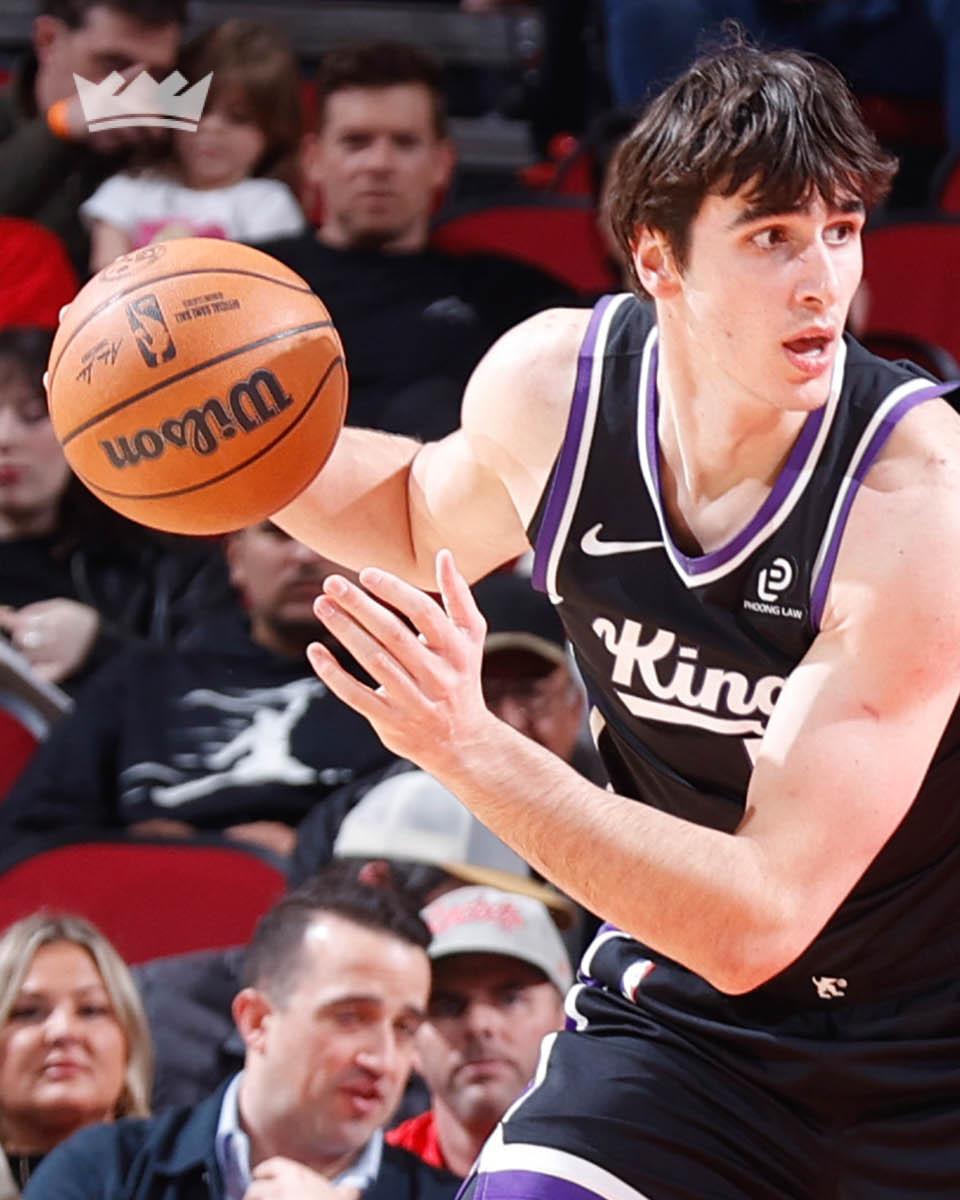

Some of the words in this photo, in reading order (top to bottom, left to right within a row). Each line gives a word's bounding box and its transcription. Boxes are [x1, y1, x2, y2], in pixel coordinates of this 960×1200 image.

[102, 367, 294, 470] Wilson
[743, 599, 780, 616] PHOONG
[781, 607, 803, 620] LAW
